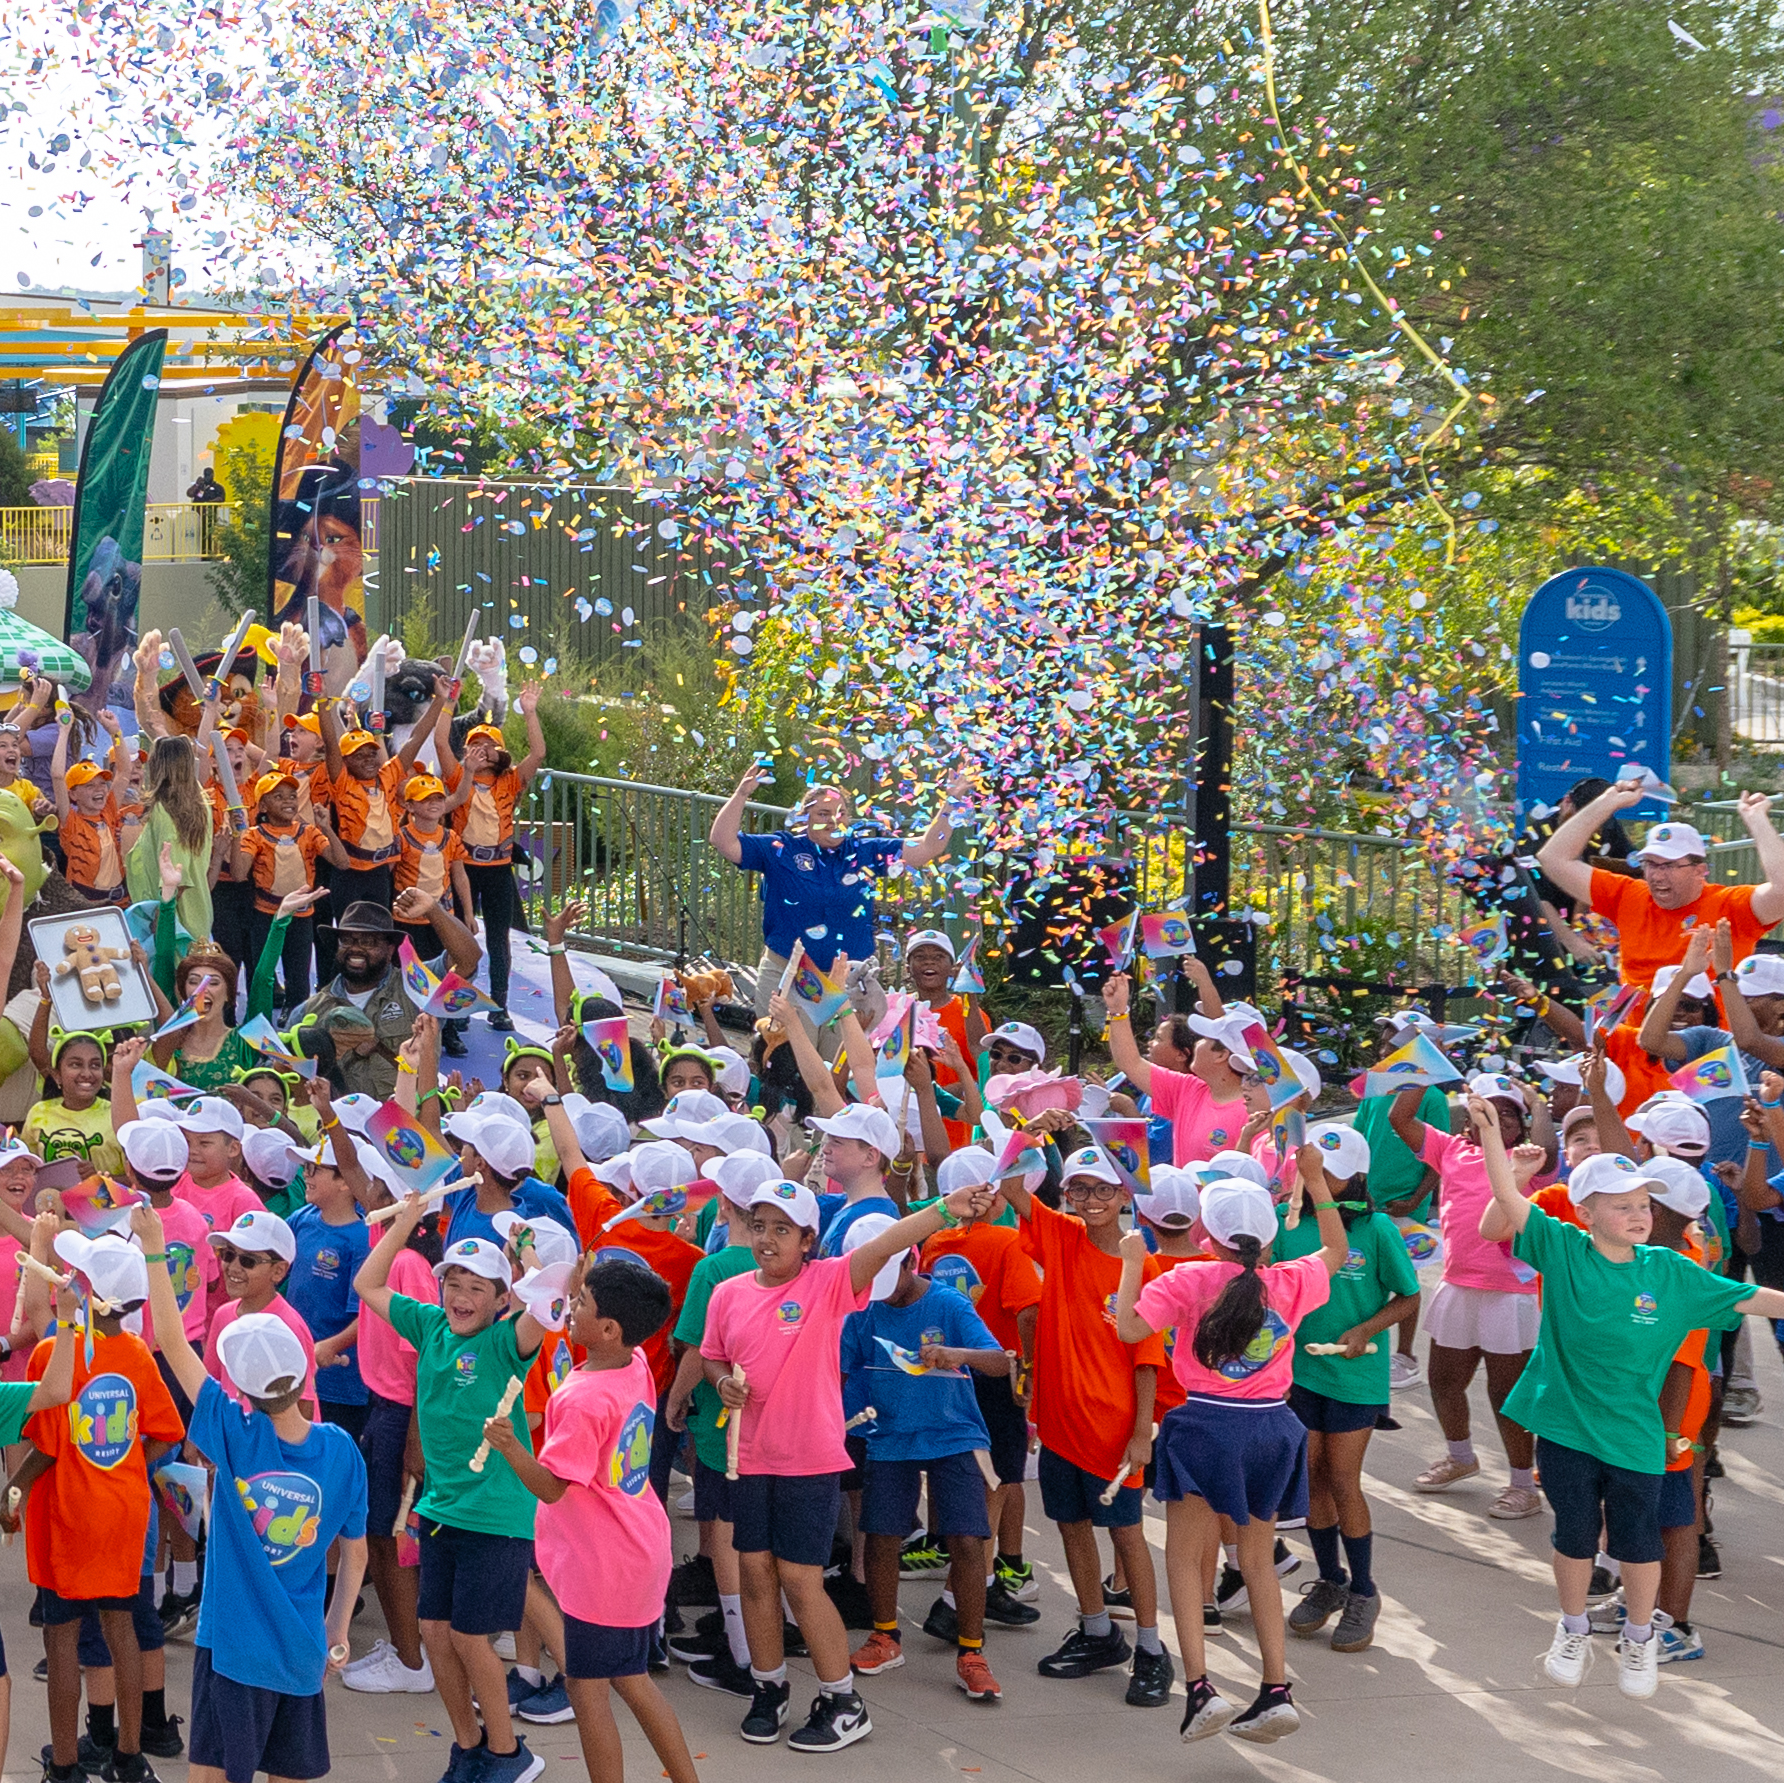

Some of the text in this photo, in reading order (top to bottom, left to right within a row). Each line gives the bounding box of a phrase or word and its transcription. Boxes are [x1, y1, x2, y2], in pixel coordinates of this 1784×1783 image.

[1565, 597, 1622, 621] kids
[1538, 762, 1593, 774] Restooms
[88, 1389, 129, 1400] UNIVERSAL
[69, 1400, 139, 1446] kids
[262, 1480, 315, 1505] UNIVERSAL
